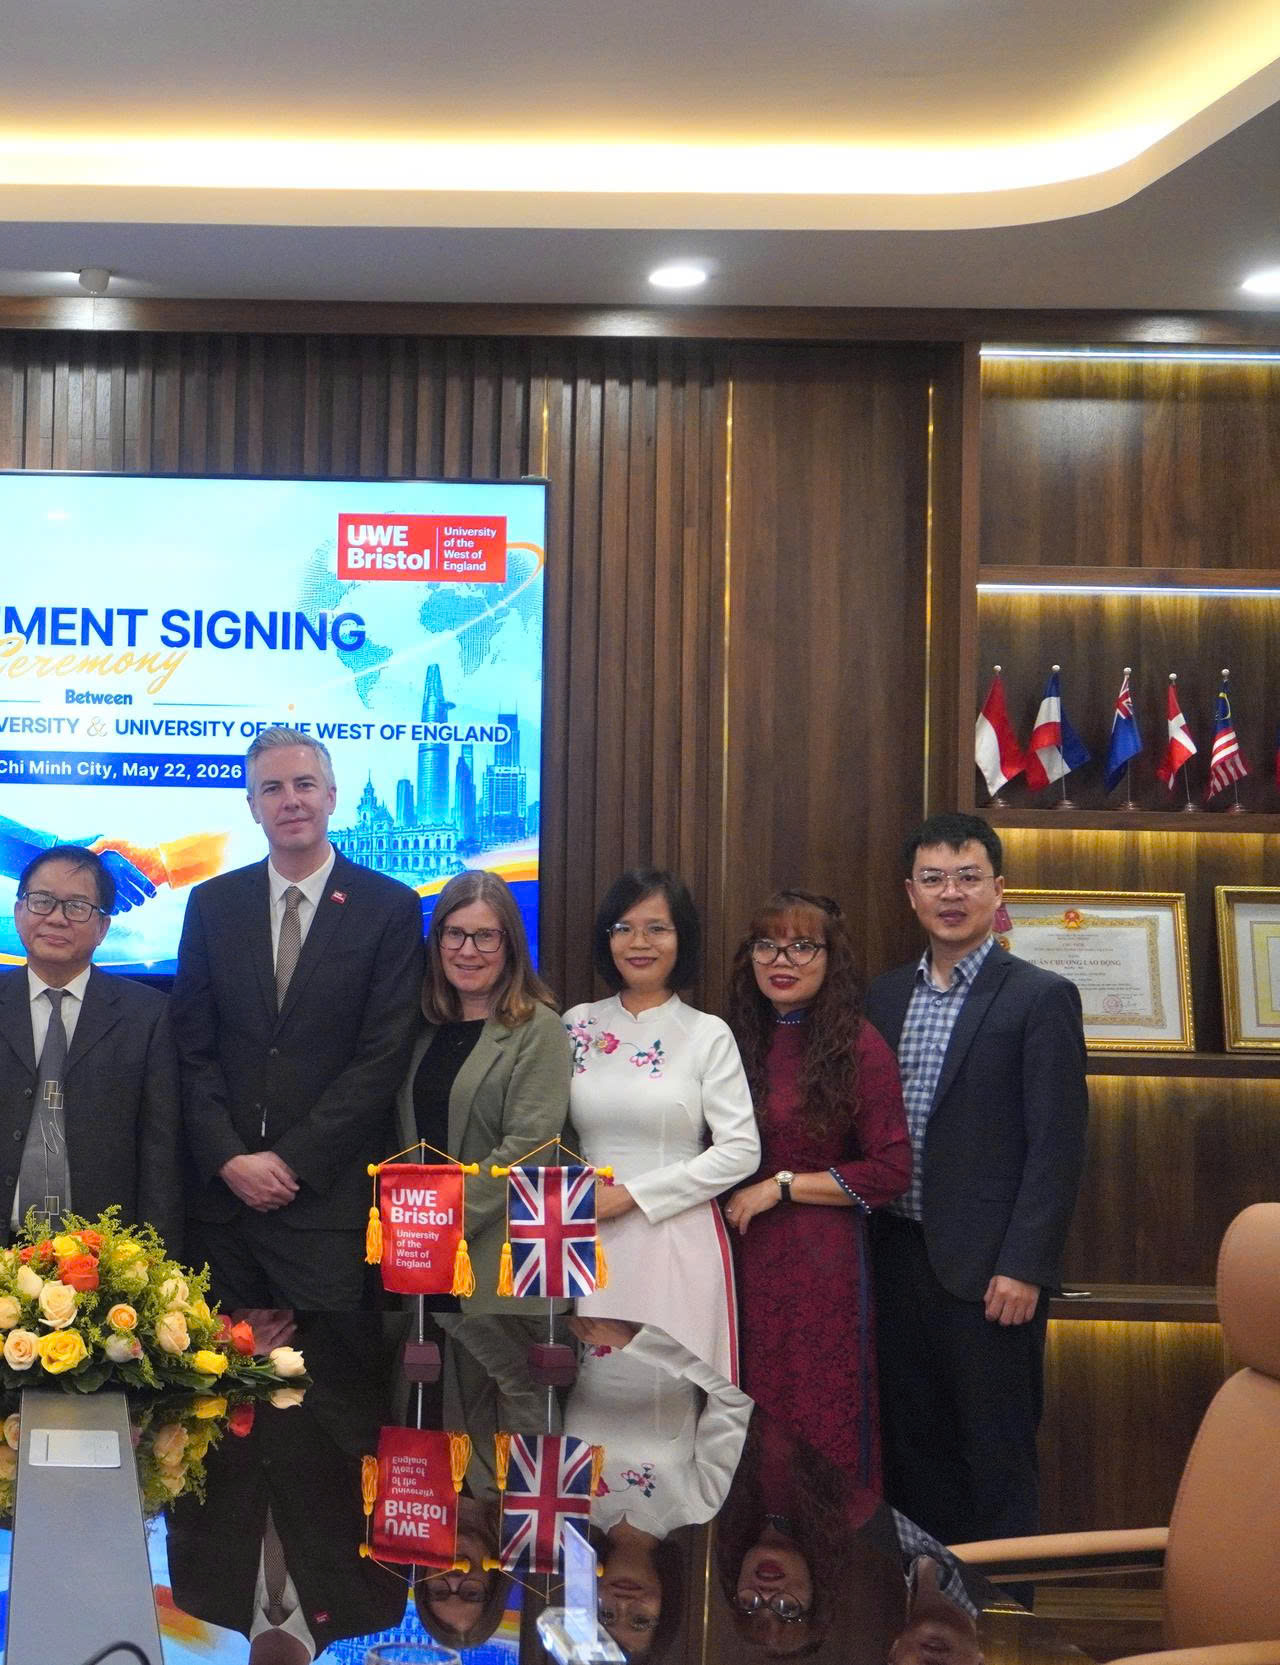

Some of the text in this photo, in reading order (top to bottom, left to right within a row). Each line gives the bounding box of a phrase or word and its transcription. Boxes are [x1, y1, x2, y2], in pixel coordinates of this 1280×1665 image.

[347, 524, 409, 547] UWE
[443, 527, 497, 539] University
[443, 538, 475, 548] of the
[347, 547, 430, 570] Bristol
[443, 550, 483, 560] West of
[443, 561, 487, 573] England
[160, 609, 366, 652] SIGNING
[65, 688, 133, 705] Between
[115, 719, 235, 737] UNIVERSITY
[240, 721, 267, 738] OF
[316, 722, 374, 740] WEST
[380, 723, 406, 740] OF
[411, 724, 509, 742] ENGLAND
[29, 760, 72, 775] Minh
[77, 761, 117, 779] City,
[123, 762, 159, 781] May
[164, 763, 191, 780] 22,
[196, 764, 242, 779] 2026
[391, 1188, 438, 1207] UWE
[390, 1206, 454, 1225] Bristol
[396, 1229, 439, 1241] University
[407, 1240, 422, 1248] the
[396, 1248, 430, 1259] West of
[395, 1258, 431, 1269] England
